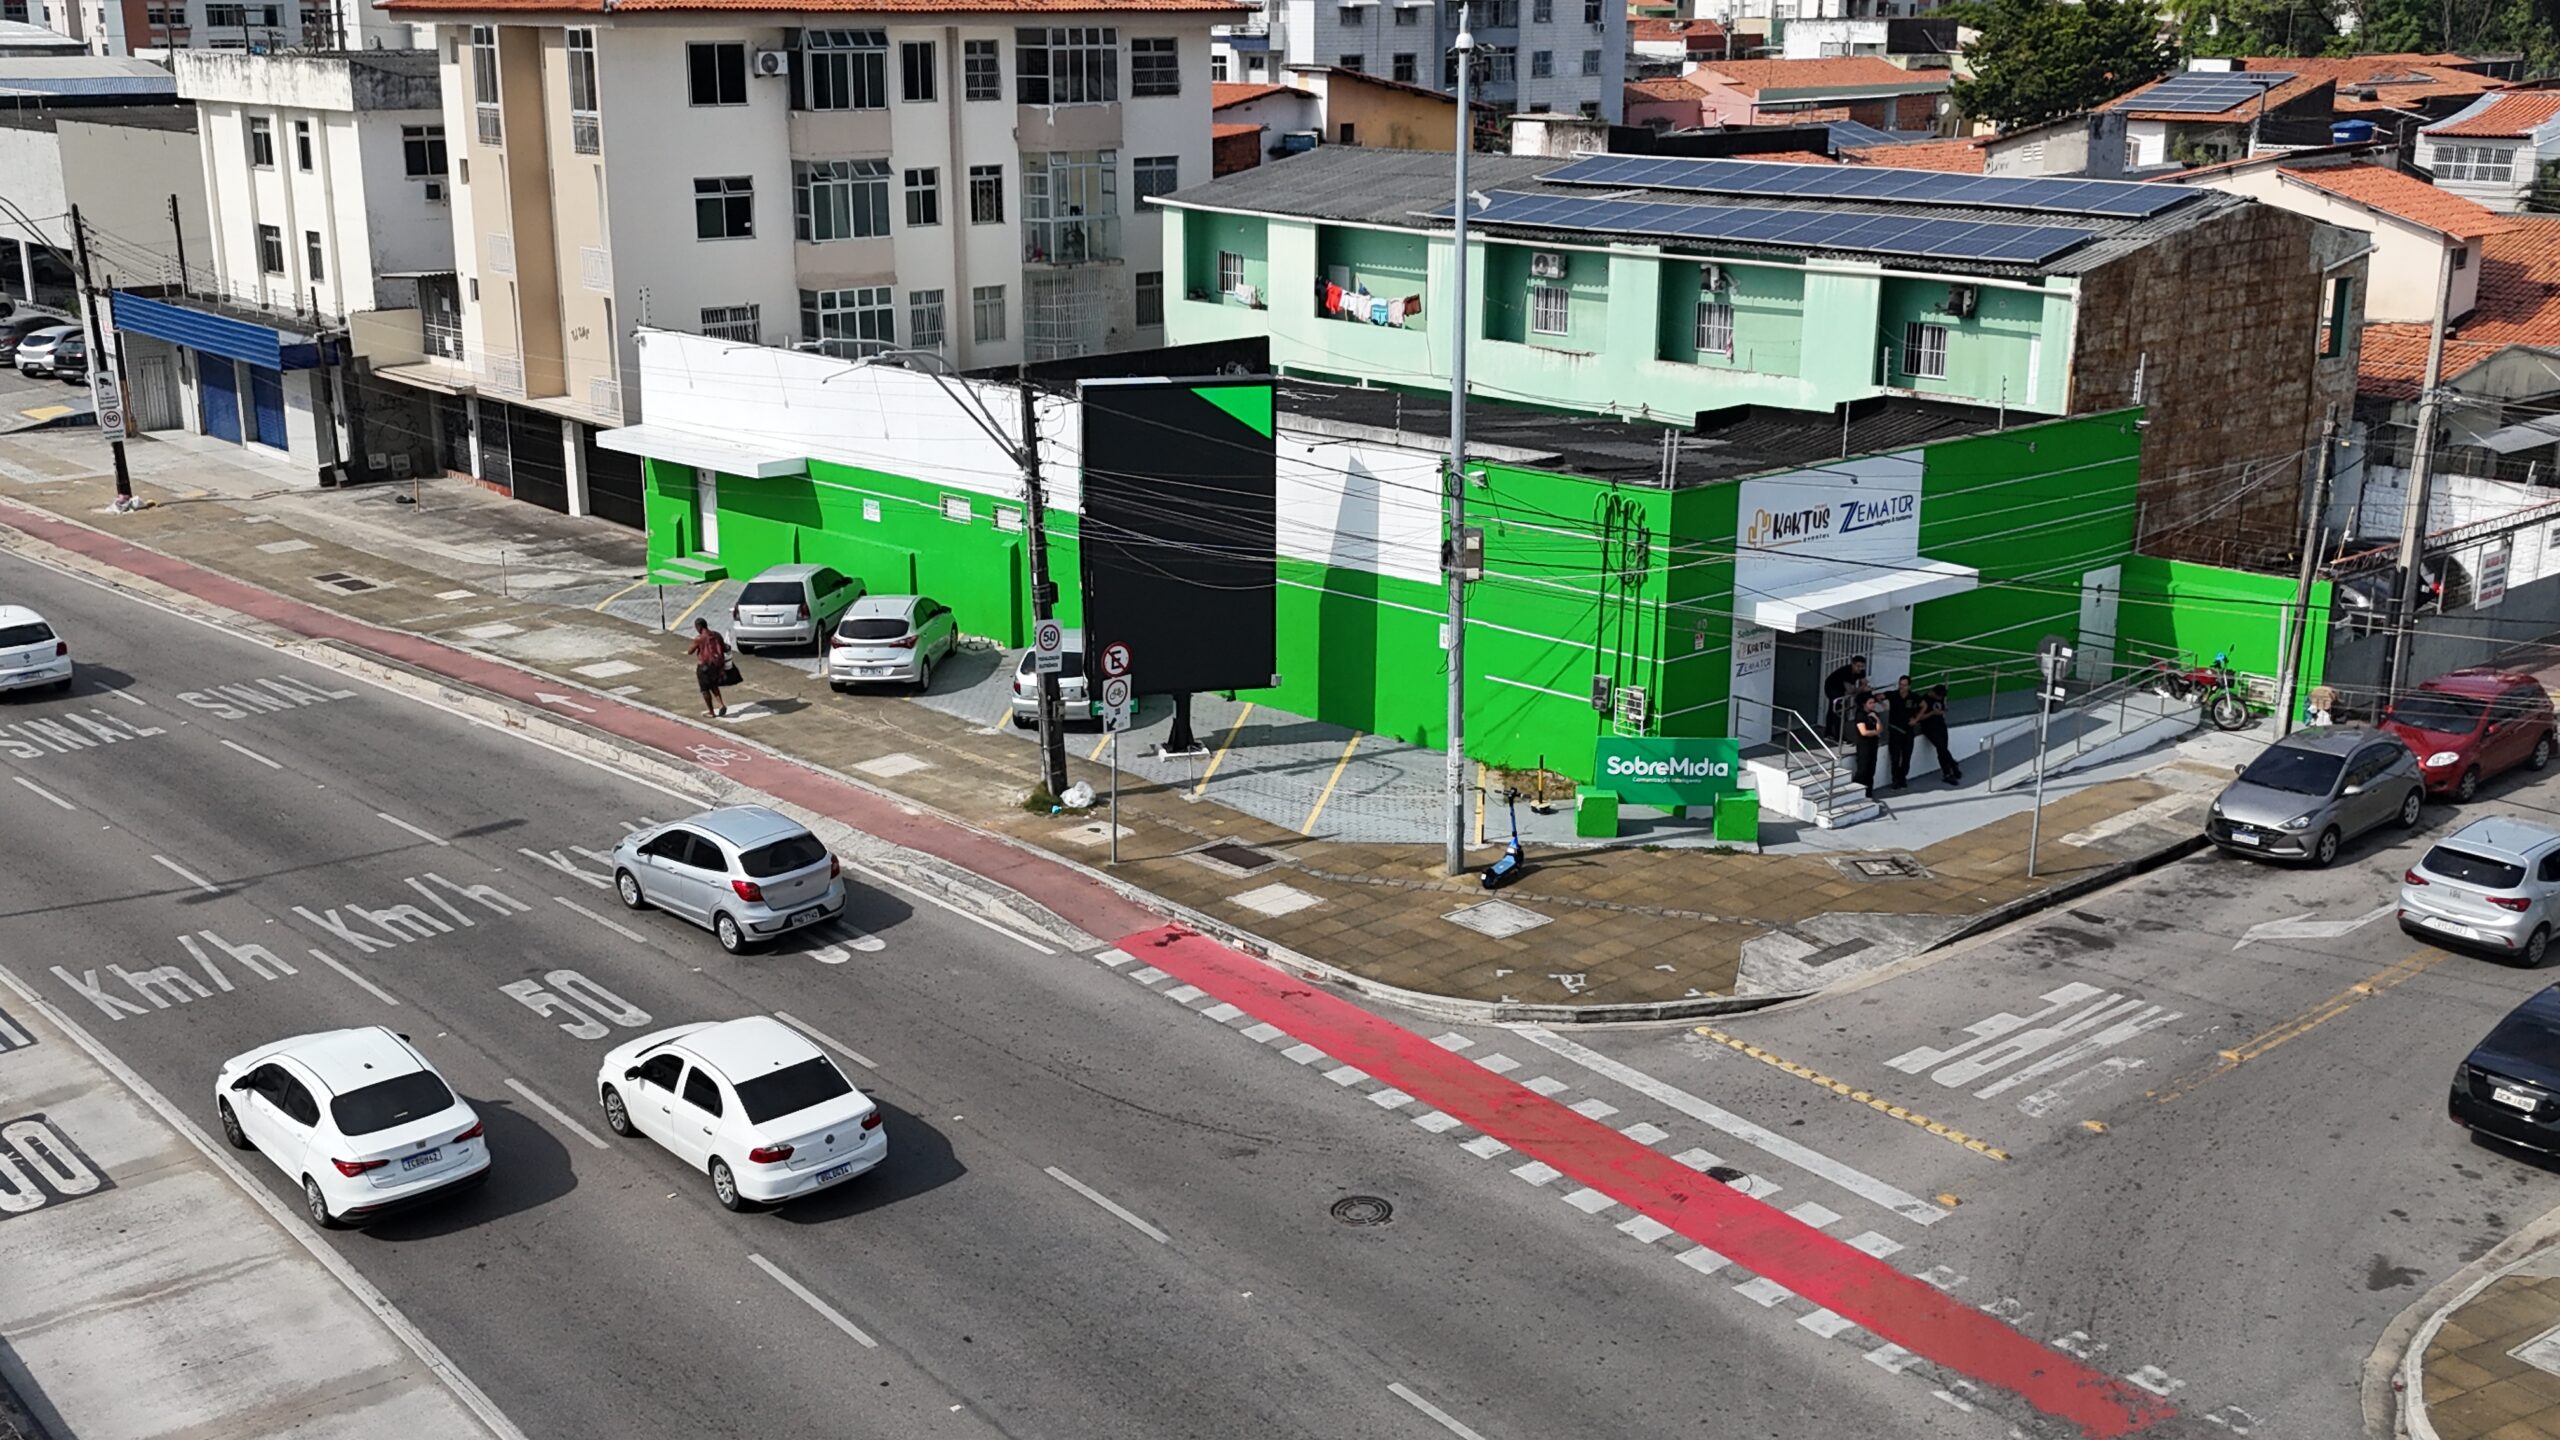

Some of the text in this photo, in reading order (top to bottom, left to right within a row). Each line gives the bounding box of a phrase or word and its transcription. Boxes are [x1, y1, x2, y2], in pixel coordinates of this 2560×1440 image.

[106, 414, 118, 423] 50
[1773, 507, 1831, 540] KAKTUS
[1839, 495, 1914, 533] ZEMATUR
[1043, 630, 1056, 642] 50
[1111, 649, 1122, 670] E
[176, 674, 358, 720] SINAL
[0, 708, 168, 759] SINAL
[1606, 755, 1730, 777] SobreMidia
[292, 872, 532, 953] Km/h
[49, 929, 300, 1021] Km/h
[499, 968, 653, 1041] 50
